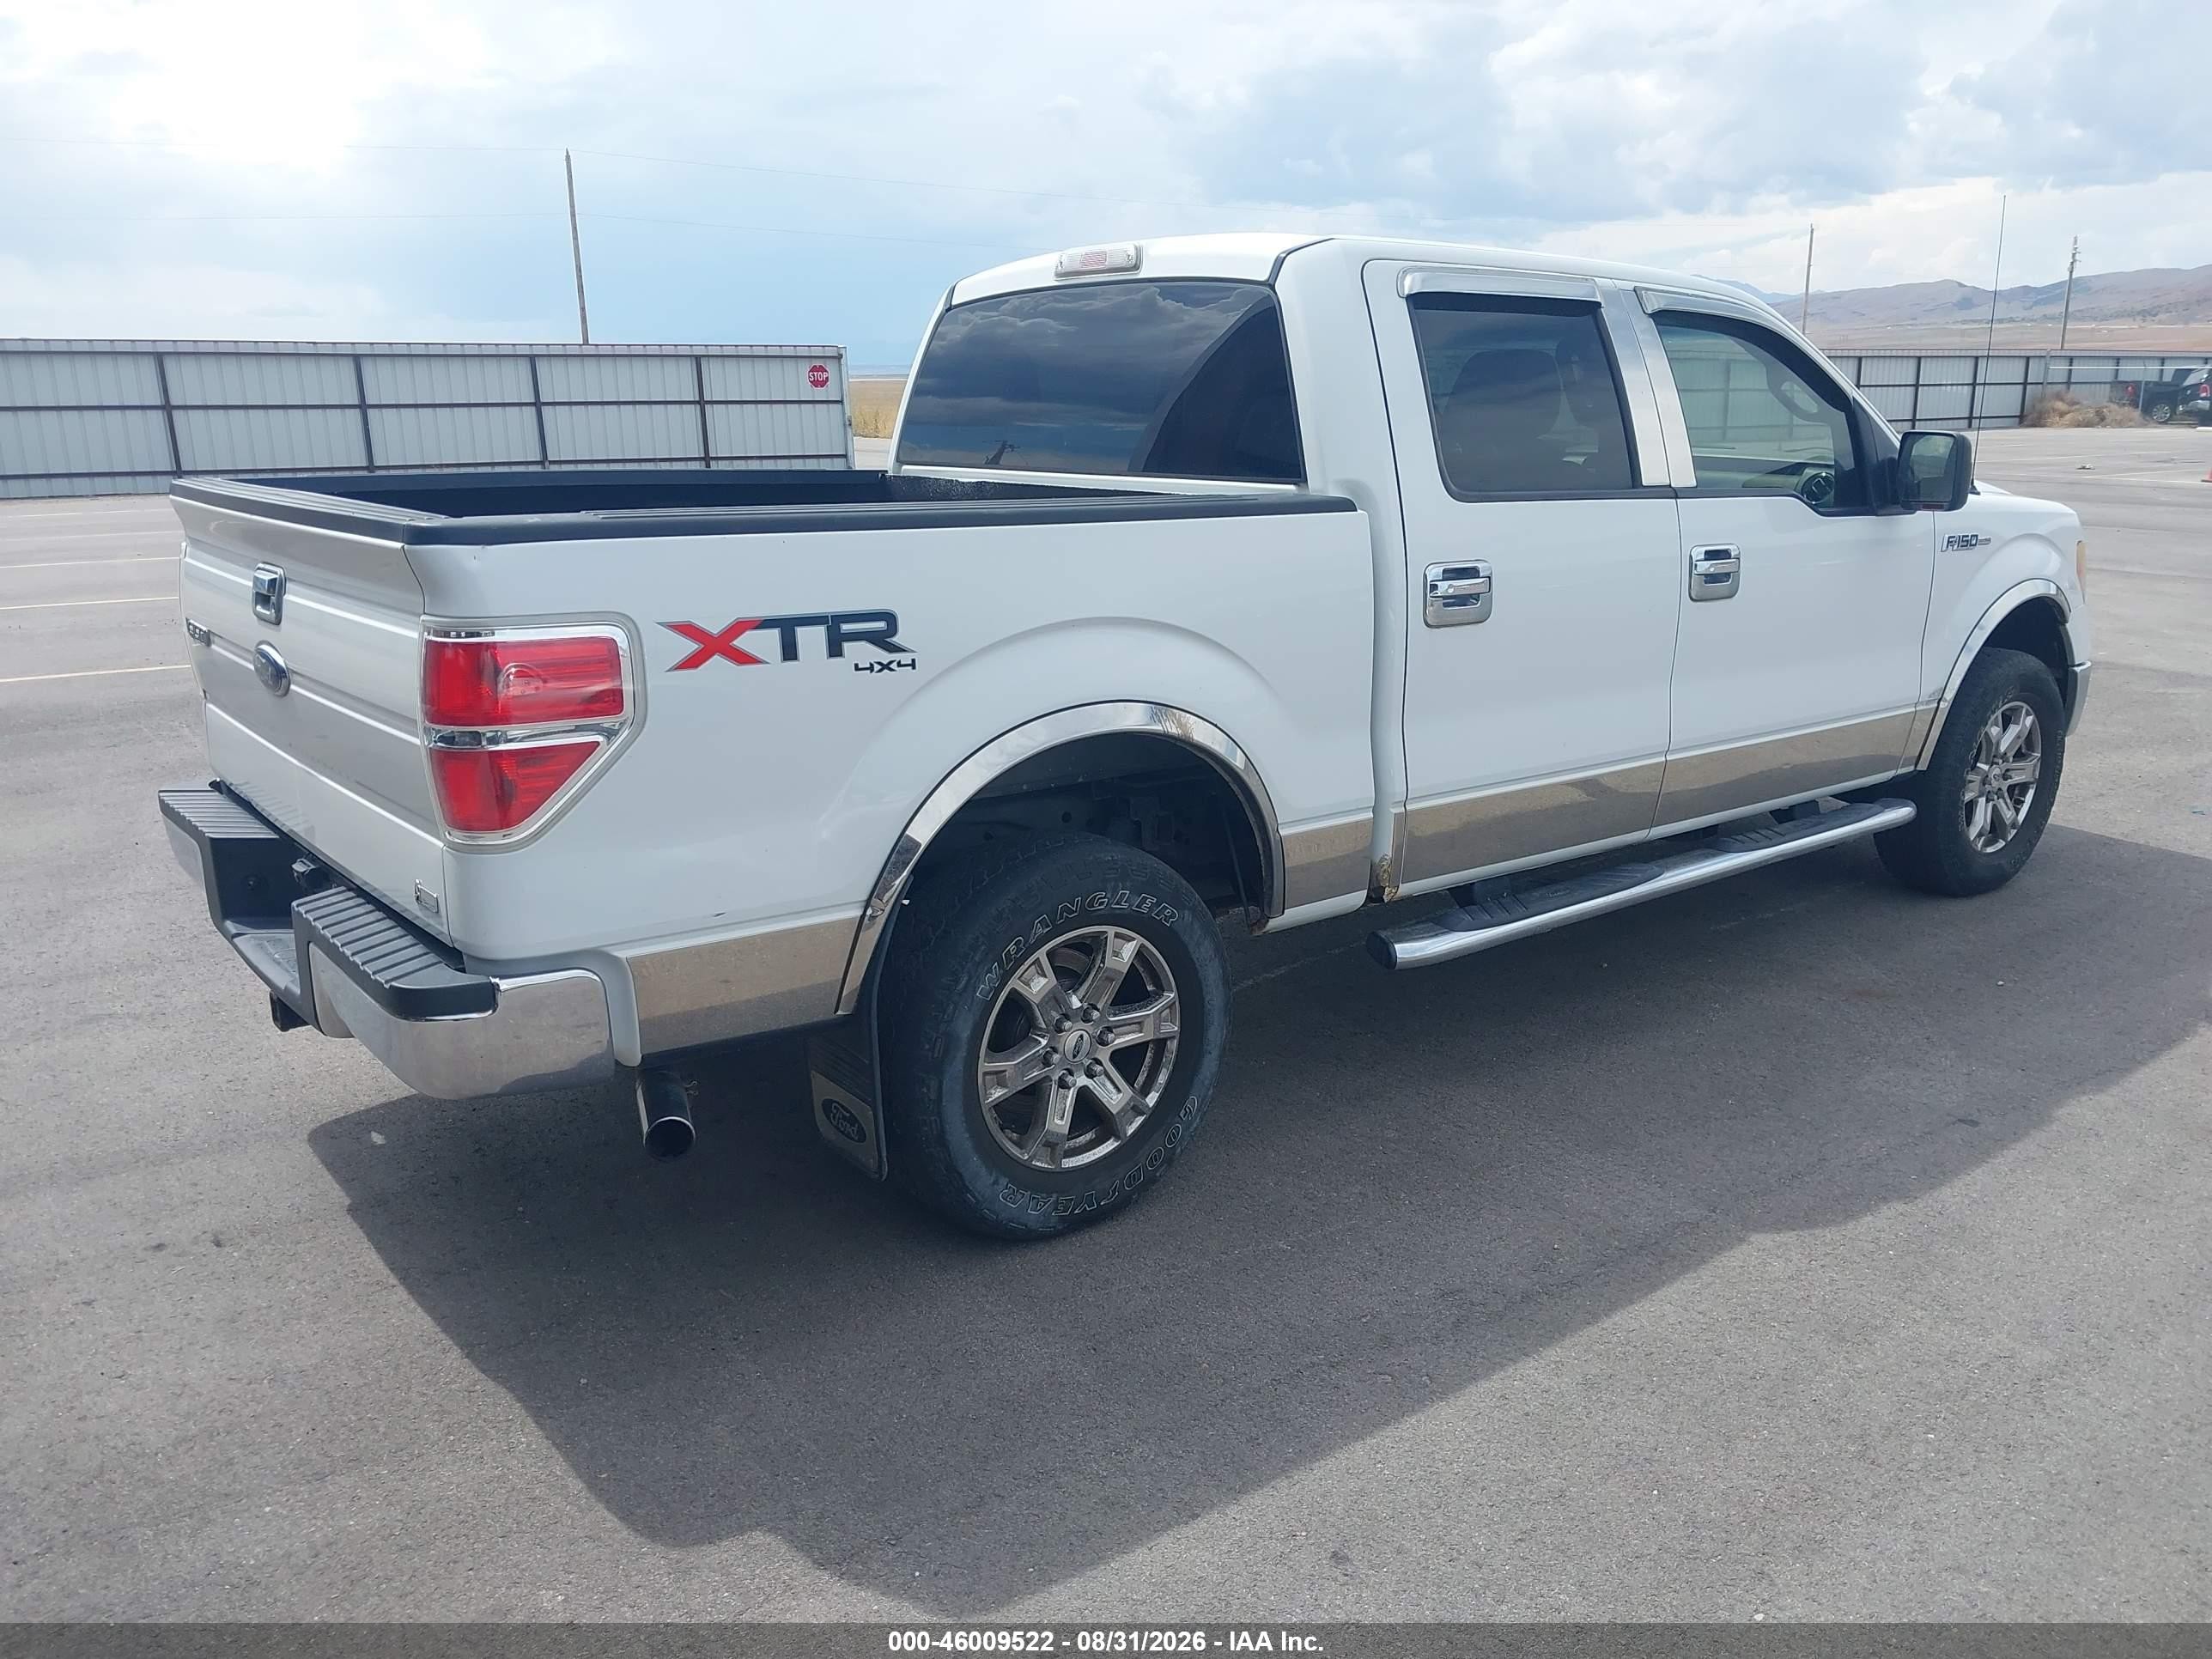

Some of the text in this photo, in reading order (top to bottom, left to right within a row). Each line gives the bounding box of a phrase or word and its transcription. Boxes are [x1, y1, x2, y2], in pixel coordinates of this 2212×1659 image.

[809, 371, 829, 381] STOP
[1944, 533, 1979, 550] F-150
[654, 608, 918, 673] XTR
[975, 890, 1180, 1001] WRANGLER
[830, 1102, 860, 1140] Ford
[999, 1095, 1199, 1216] GOODYEAR
